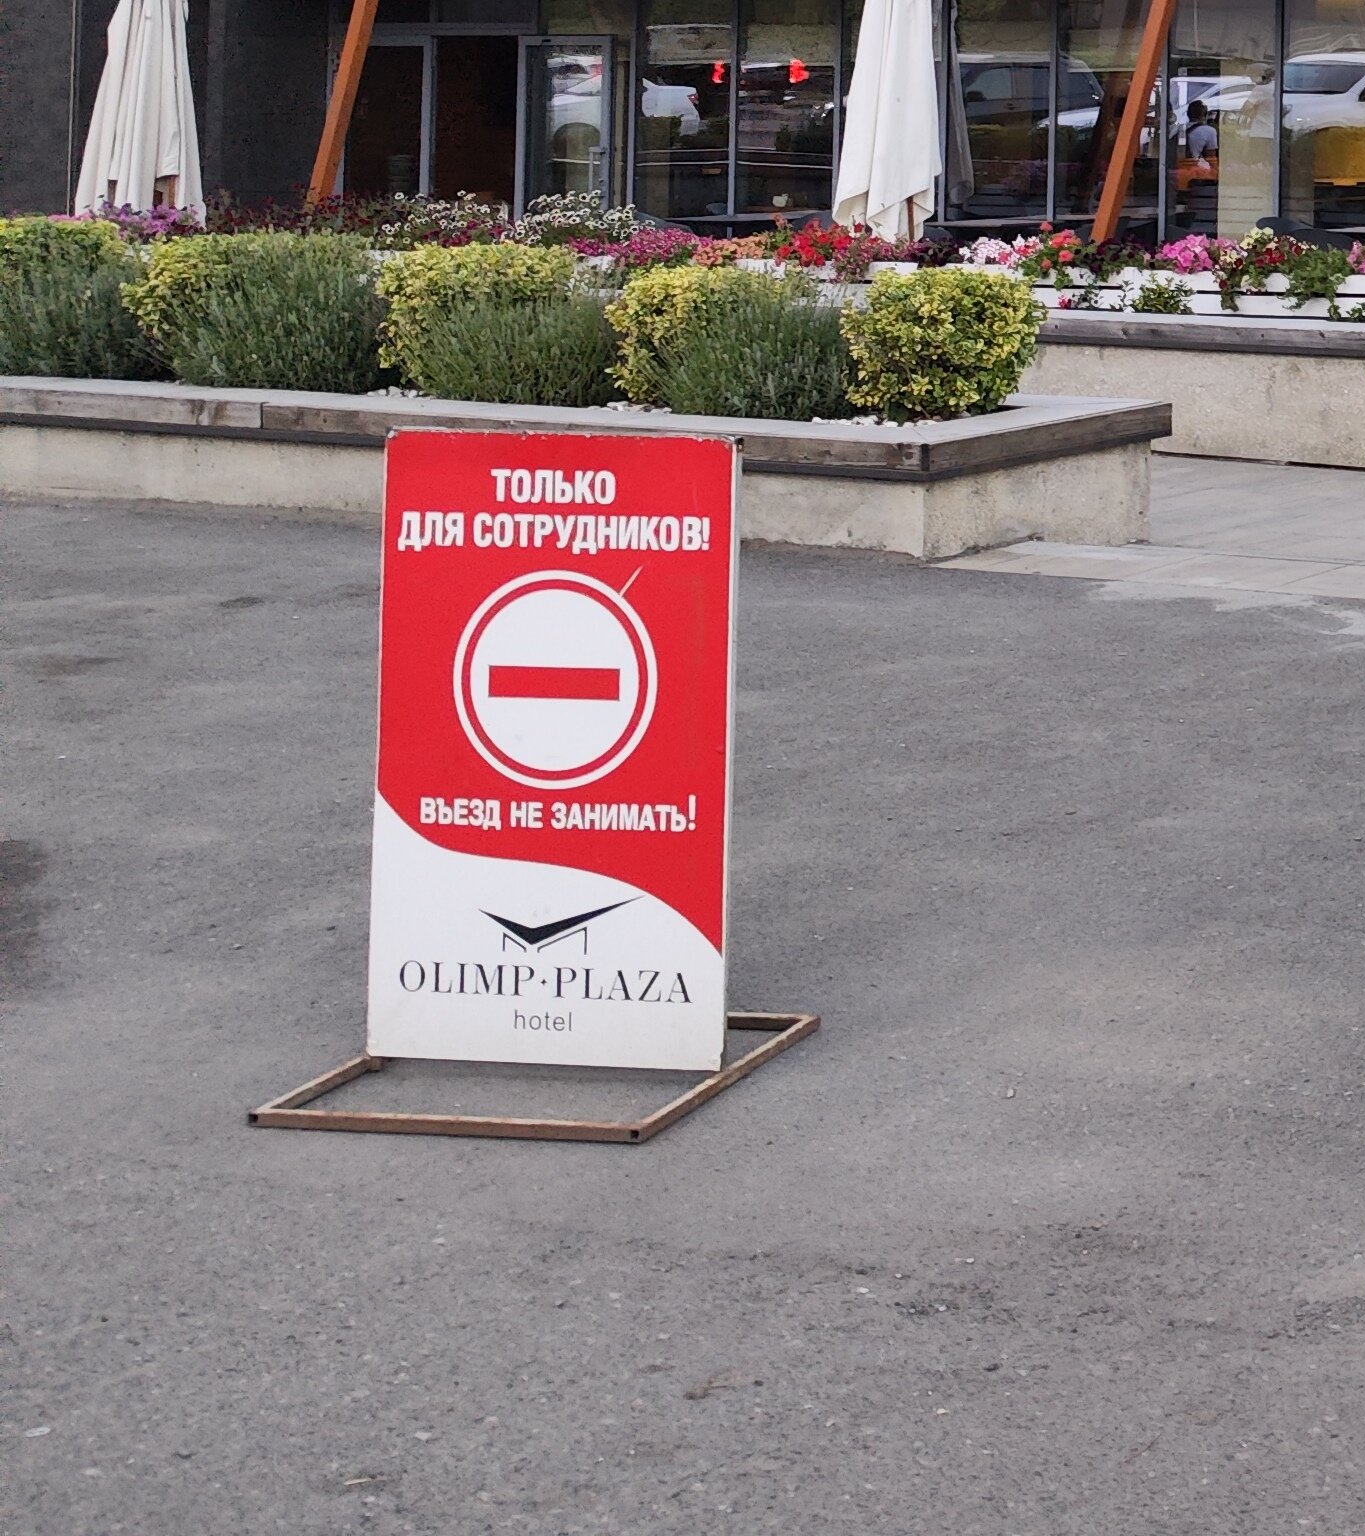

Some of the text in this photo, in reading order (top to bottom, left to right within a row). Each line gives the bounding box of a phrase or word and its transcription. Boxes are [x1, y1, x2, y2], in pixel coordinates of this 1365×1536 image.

[491, 468, 616, 505] ТОЛЬКО
[398, 511, 710, 554] ДЛЯ СОТРУДНИКОВ!
[419, 794, 697, 833] ВЪЕЗД НЕ ЗАНИМАТЬ!
[514, 1009, 572, 1031] hotel
